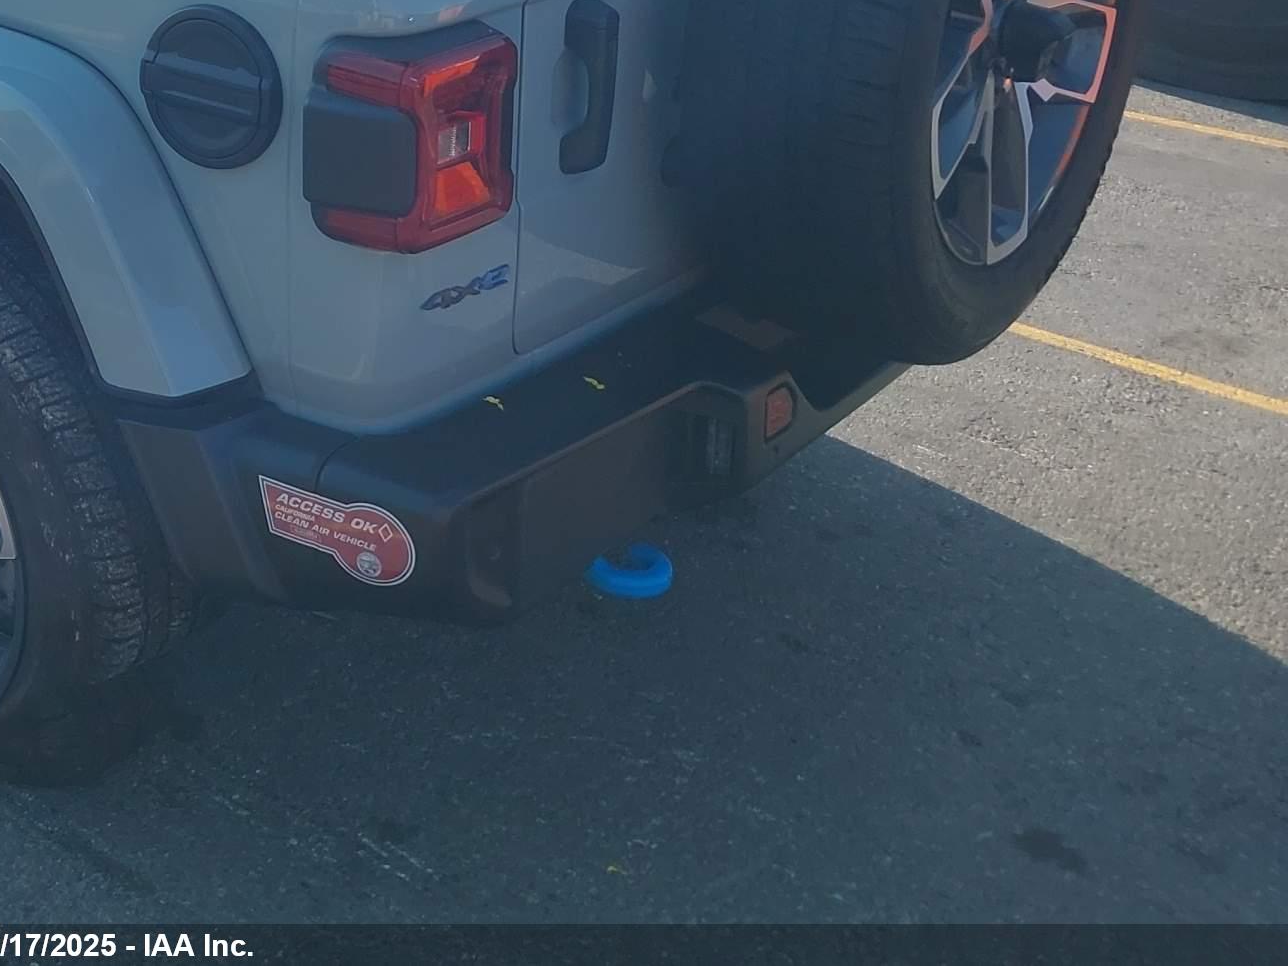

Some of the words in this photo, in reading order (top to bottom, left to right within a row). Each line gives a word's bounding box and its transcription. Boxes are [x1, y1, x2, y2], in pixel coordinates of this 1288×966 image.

[275, 504, 315, 522] CALIFORNIA
[275, 511, 310, 529] CLEAN
[311, 524, 331, 536] AIR
[333, 530, 377, 551] VEHICLE
[276, 492, 346, 523] ACCESS
[350, 518, 378, 534] OK
